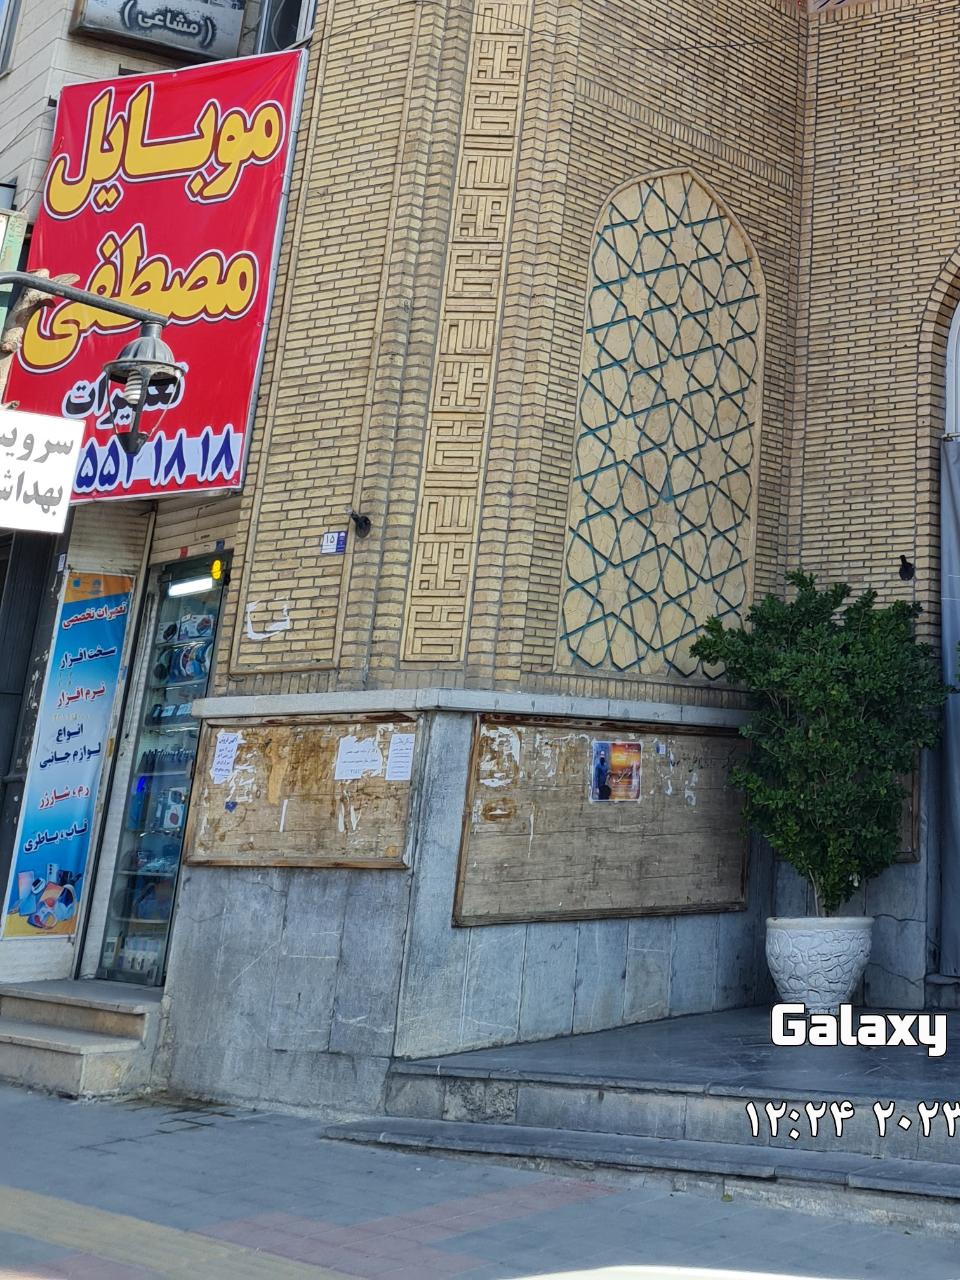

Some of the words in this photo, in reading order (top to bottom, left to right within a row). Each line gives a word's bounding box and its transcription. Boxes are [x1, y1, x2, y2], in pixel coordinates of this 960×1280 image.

[43, 81, 285, 220] موبایل
[18, 223, 259, 374] مصطفی
[62, 607, 97, 630] تخصصی
[60, 647, 87, 671] افزار
[88, 644, 118, 660] سخت
[57, 686, 84, 709] افزار
[85, 682, 107, 701] نرم
[55, 722, 85, 743] انواع
[40, 750, 71, 769] جانبی
[72, 742, 102, 762] لوازم
